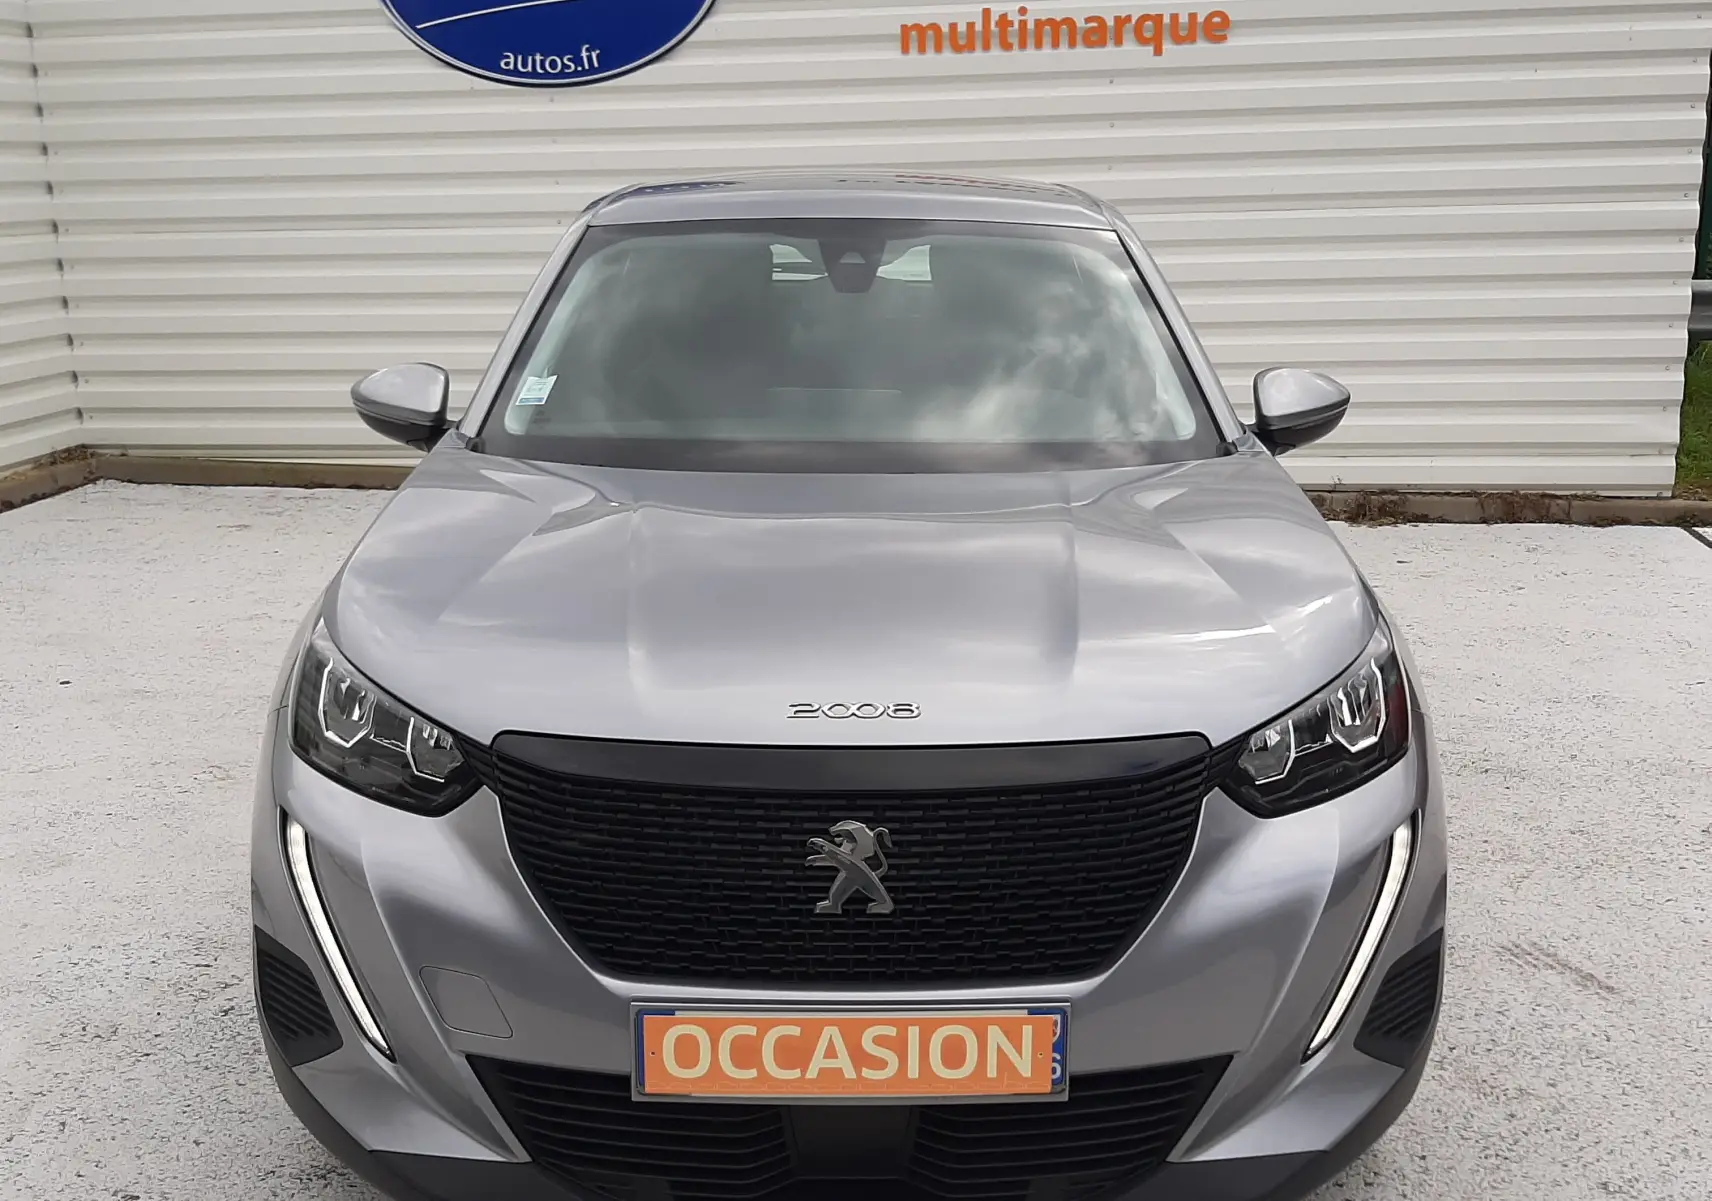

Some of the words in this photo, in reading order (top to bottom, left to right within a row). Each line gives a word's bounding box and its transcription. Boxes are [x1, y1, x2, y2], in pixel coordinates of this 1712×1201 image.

[900, 6, 1231, 56] multimarque
[500, 45, 600, 73] autos.fr
[786, 702, 922, 719] 2008
[661, 1024, 1034, 1080] OCCASION
